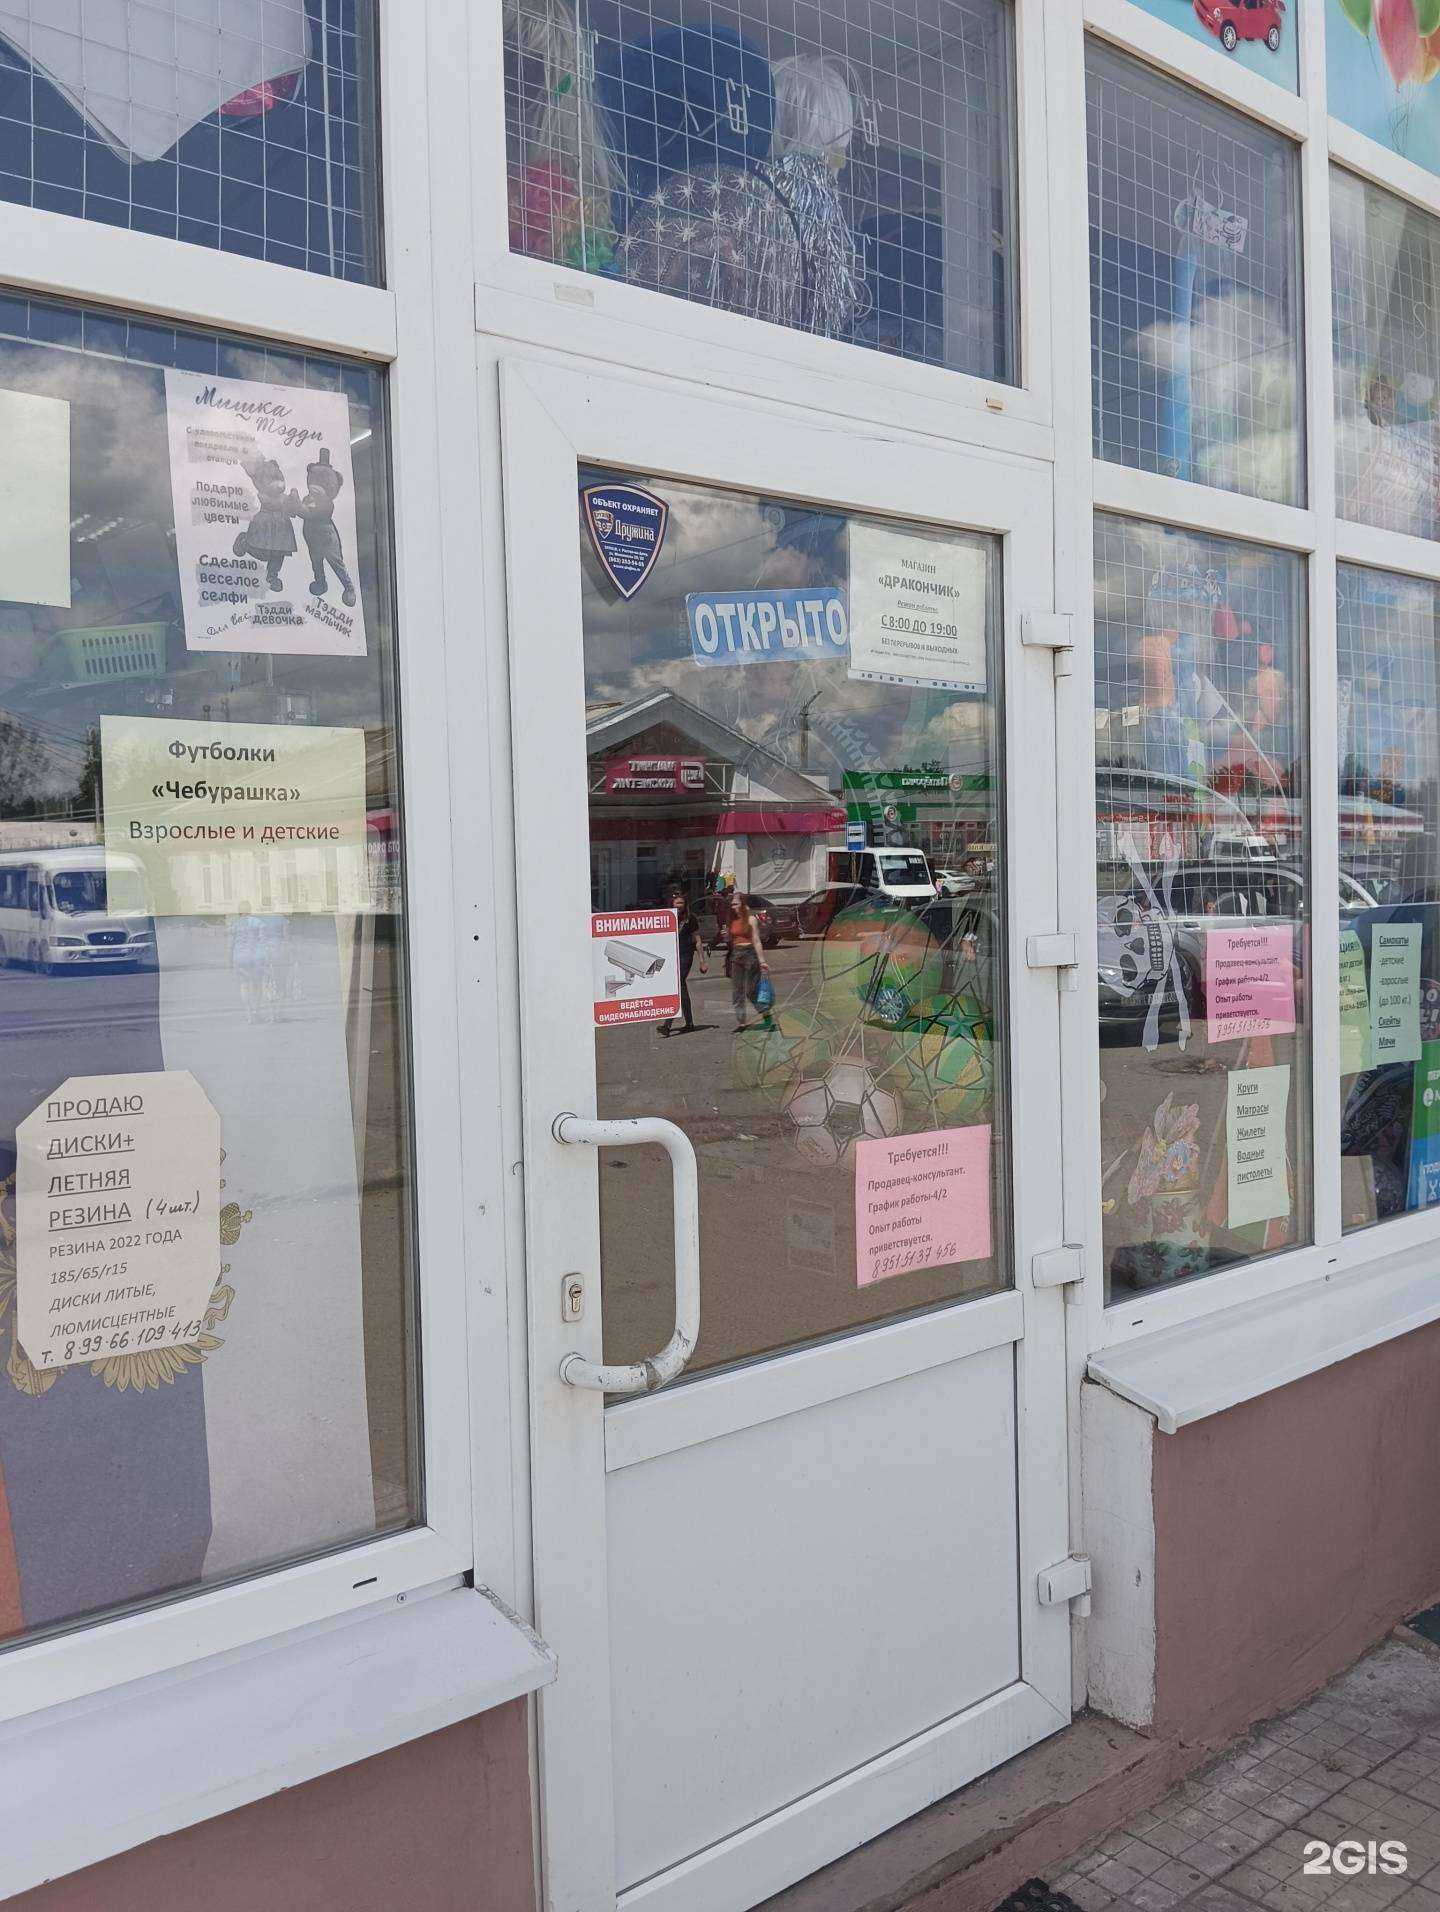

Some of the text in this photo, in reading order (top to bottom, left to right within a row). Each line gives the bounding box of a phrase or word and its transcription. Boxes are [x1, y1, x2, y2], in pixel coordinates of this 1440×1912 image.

[196, 481, 243, 497] Подарю
[192, 497, 249, 512] любимые
[592, 497, 659, 516] ОБЪЕКТ ОХРАНЯЕТ
[203, 512, 240, 524] цветы
[615, 520, 655, 541] Дружина
[199, 554, 258, 571] Сделаю
[901, 559, 936, 574] МАГАЗИН
[200, 573, 260, 588] веселое
[879, 575, 960, 598] «ДРАКОНЧИК»
[201, 590, 248, 605] селфи
[252, 614, 304, 626] девочка
[258, 605, 292, 615] Тэдди
[316, 597, 354, 627] Тэдди
[305, 605, 352, 638] мальчик
[694, 598, 848, 654] ОТКРЫТО
[881, 615, 957, 636] С 8:00 ДО 19:00
[168, 740, 276, 764] Футболки
[152, 781, 300, 804] «Чебурашка»
[130, 820, 339, 843] Взрослые и детские
[595, 915, 670, 933] ВНИМАНИЕ!!!
[1227, 937, 1268, 949] Требуется!!!
[1215, 977, 1236, 987] График
[1215, 993, 1253, 1004] Опыт работы
[599, 1007, 675, 1022] ВИДЕОНАБЛЮДЕНИЕ
[1237, 1083, 1259, 1094] Круги
[48, 1095, 143, 1119] ПРОДАЮ
[1237, 1103, 1270, 1116] Матрасы
[1237, 1126, 1266, 1139] Жилеты
[48, 1132, 135, 1158] ДИСКИ+
[887, 1143, 949, 1166] Требуется!!!
[1237, 1148, 1265, 1162] Водные
[48, 1168, 131, 1194] ЛЕТНЯЯ
[868, 1167, 966, 1192] Продавец-консультант.
[1237, 1167, 1273, 1183] пистолеты
[50, 1202, 132, 1228] РЕЗИНА
[868, 1199, 899, 1216] График
[869, 1215, 922, 1236] Опыт работы
[50, 1229, 183, 1259] РЕЗИНА 2022 ГОДА
[869, 1233, 933, 1256] приветствуется.
[50, 1262, 128, 1285] 185/65/r15
[49, 1284, 156, 1313] ДИСКИ ЛИТЫЕ,
[50, 1305, 177, 1338] ЛЮМИСЦЕНТНЫЕ
